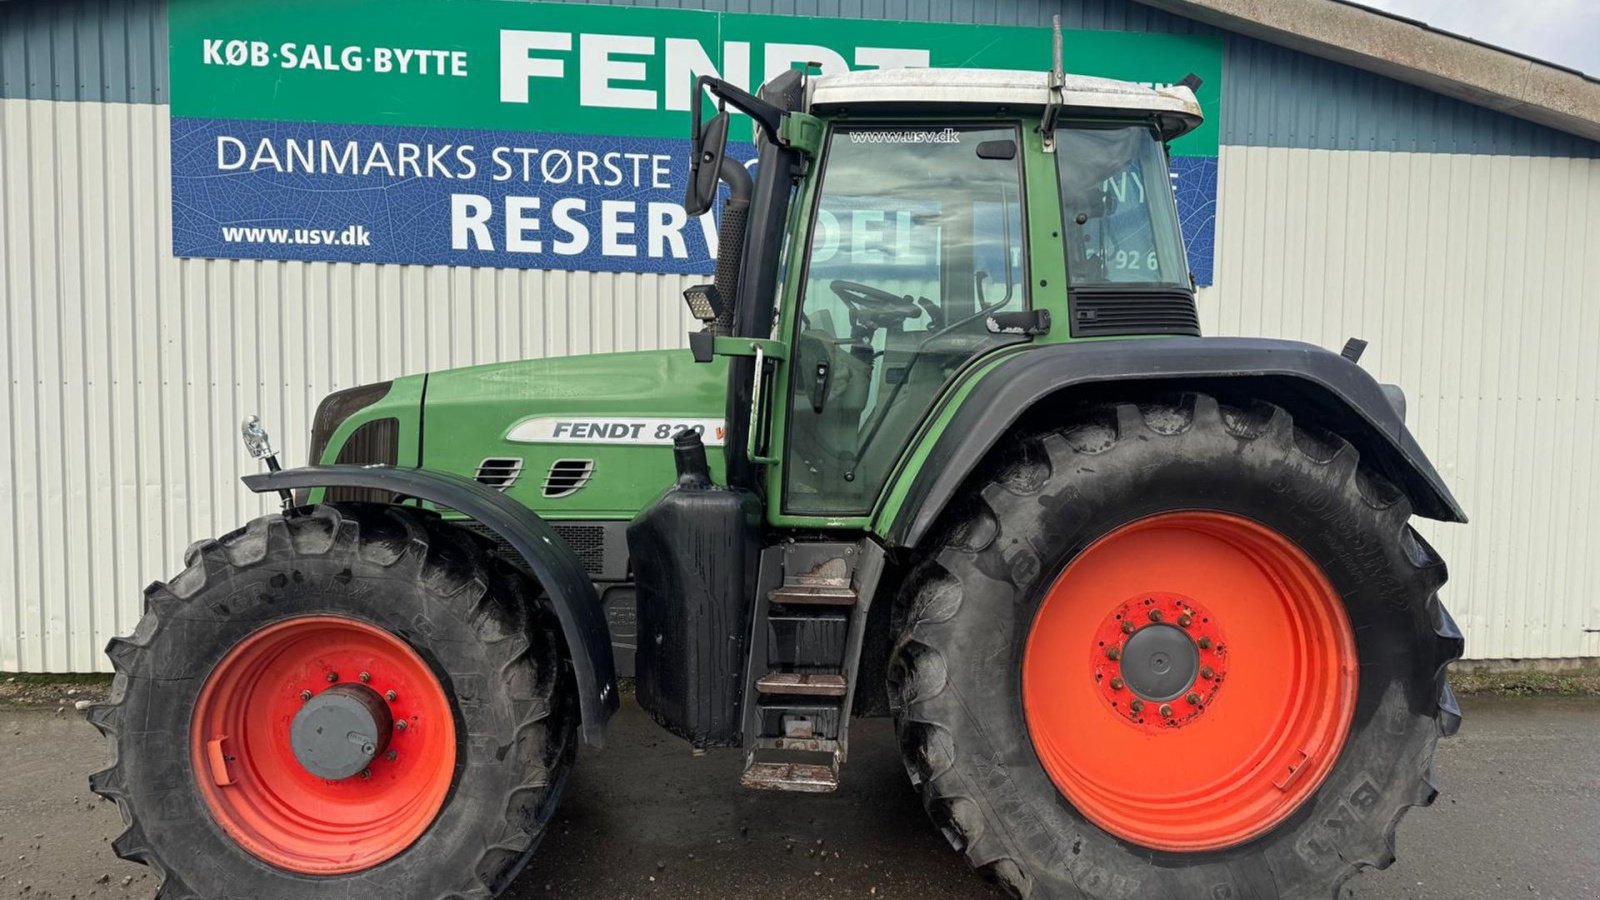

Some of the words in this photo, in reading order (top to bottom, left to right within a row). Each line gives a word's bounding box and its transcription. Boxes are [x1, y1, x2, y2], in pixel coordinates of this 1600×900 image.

[849, 128, 960, 144] www.usv.dk
[217, 136, 478, 179] DANMARKS
[492, 146, 672, 189] STØRSTE
[222, 224, 371, 247] www.usv.dk
[552, 422, 646, 439] FENDT
